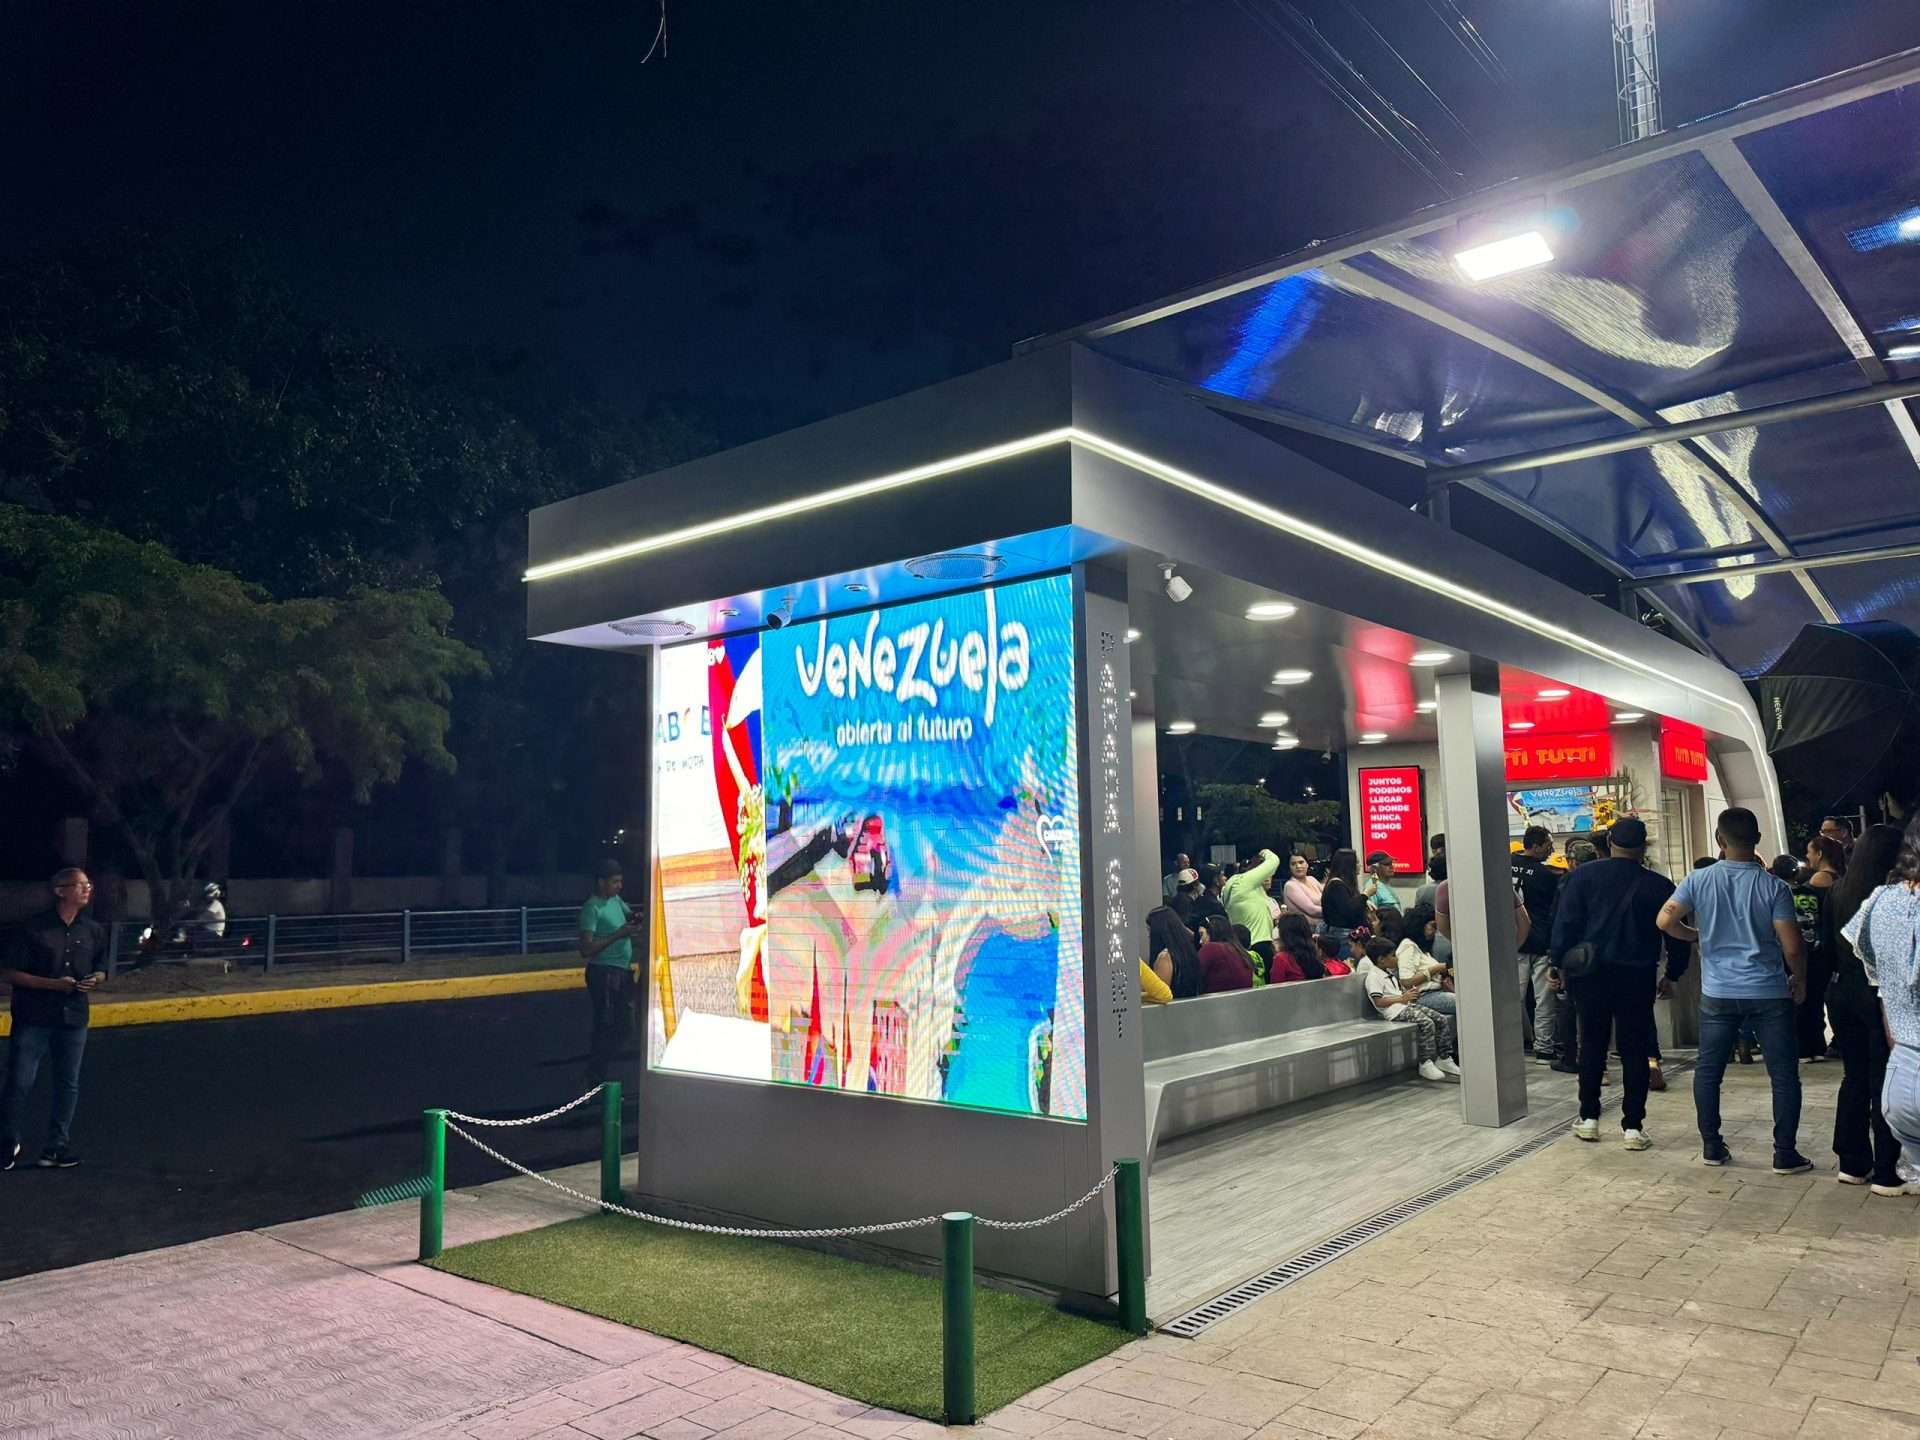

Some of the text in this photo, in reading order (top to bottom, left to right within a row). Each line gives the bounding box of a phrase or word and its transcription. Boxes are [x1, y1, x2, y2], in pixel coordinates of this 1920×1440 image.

[898, 713, 912, 742] al
[918, 712, 973, 741] futuro
[1536, 746, 1596, 765] TUTTI
[1368, 777, 1402, 785] JUNTOS
[1369, 786, 1412, 794] PODEMOS
[1369, 795, 1402, 804] LLEGAR
[1378, 804, 1410, 812] DONDE
[1370, 813, 1401, 821] NUNCA
